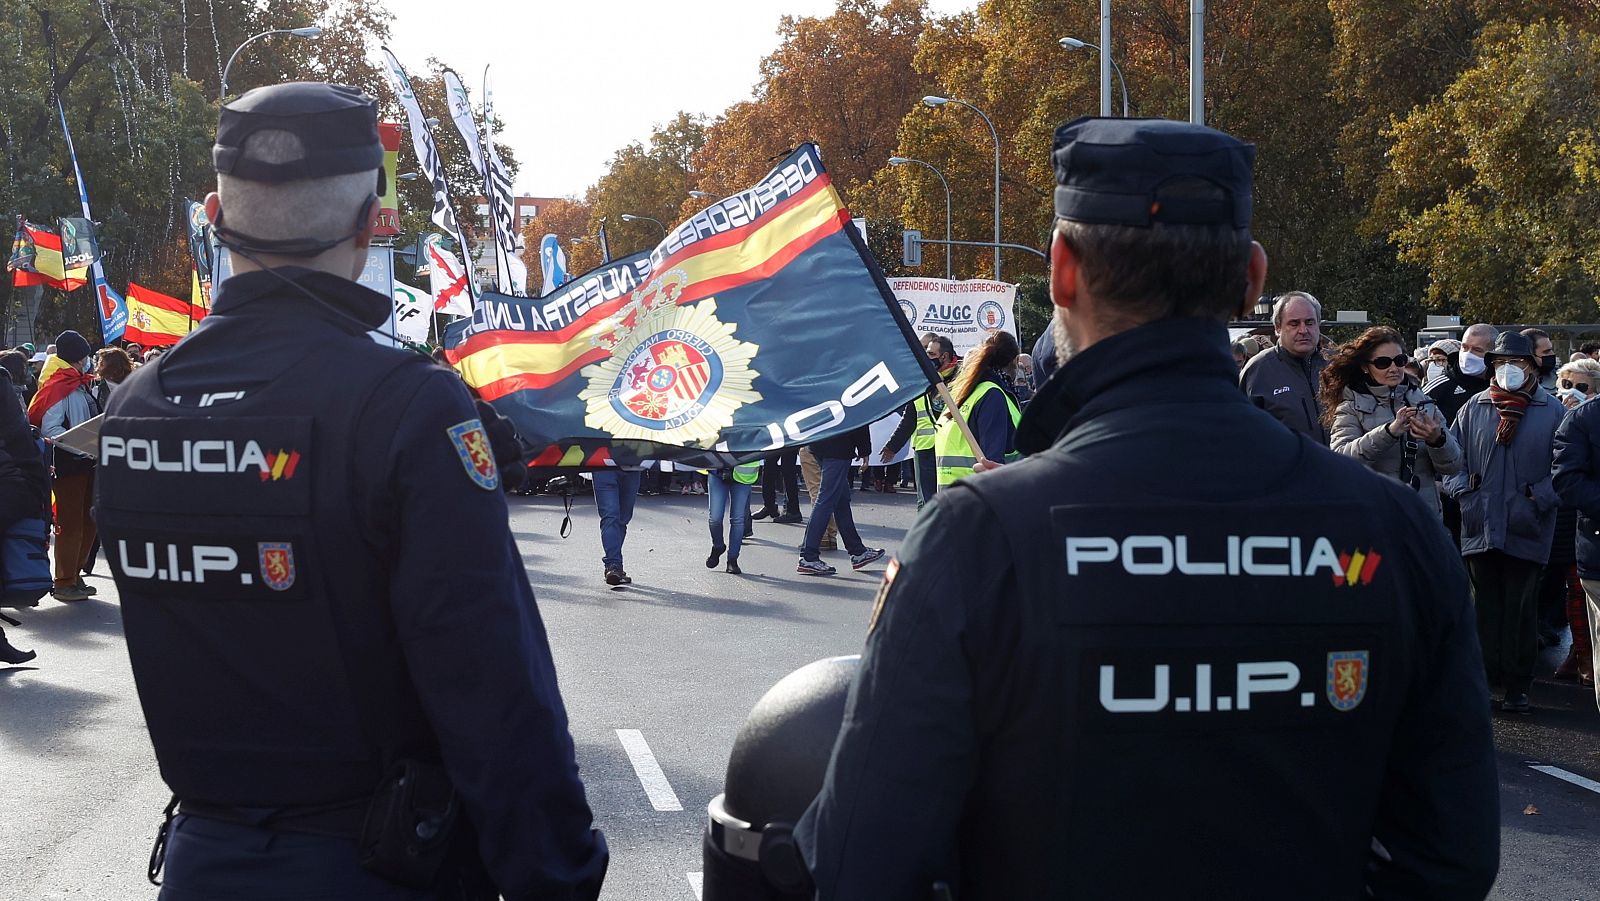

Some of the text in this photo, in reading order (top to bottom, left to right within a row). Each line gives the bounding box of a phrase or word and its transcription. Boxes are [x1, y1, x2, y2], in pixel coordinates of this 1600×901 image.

[893, 281, 939, 293] DEFENDEMOS
[941, 283, 968, 293] NUESTROS
[925, 303, 972, 320] AUGC
[101, 435, 270, 473] POLICIA
[118, 539, 253, 585] U.I.P.
[1066, 535, 1345, 576] POLICIA
[1099, 661, 1315, 713] U.I.P.
